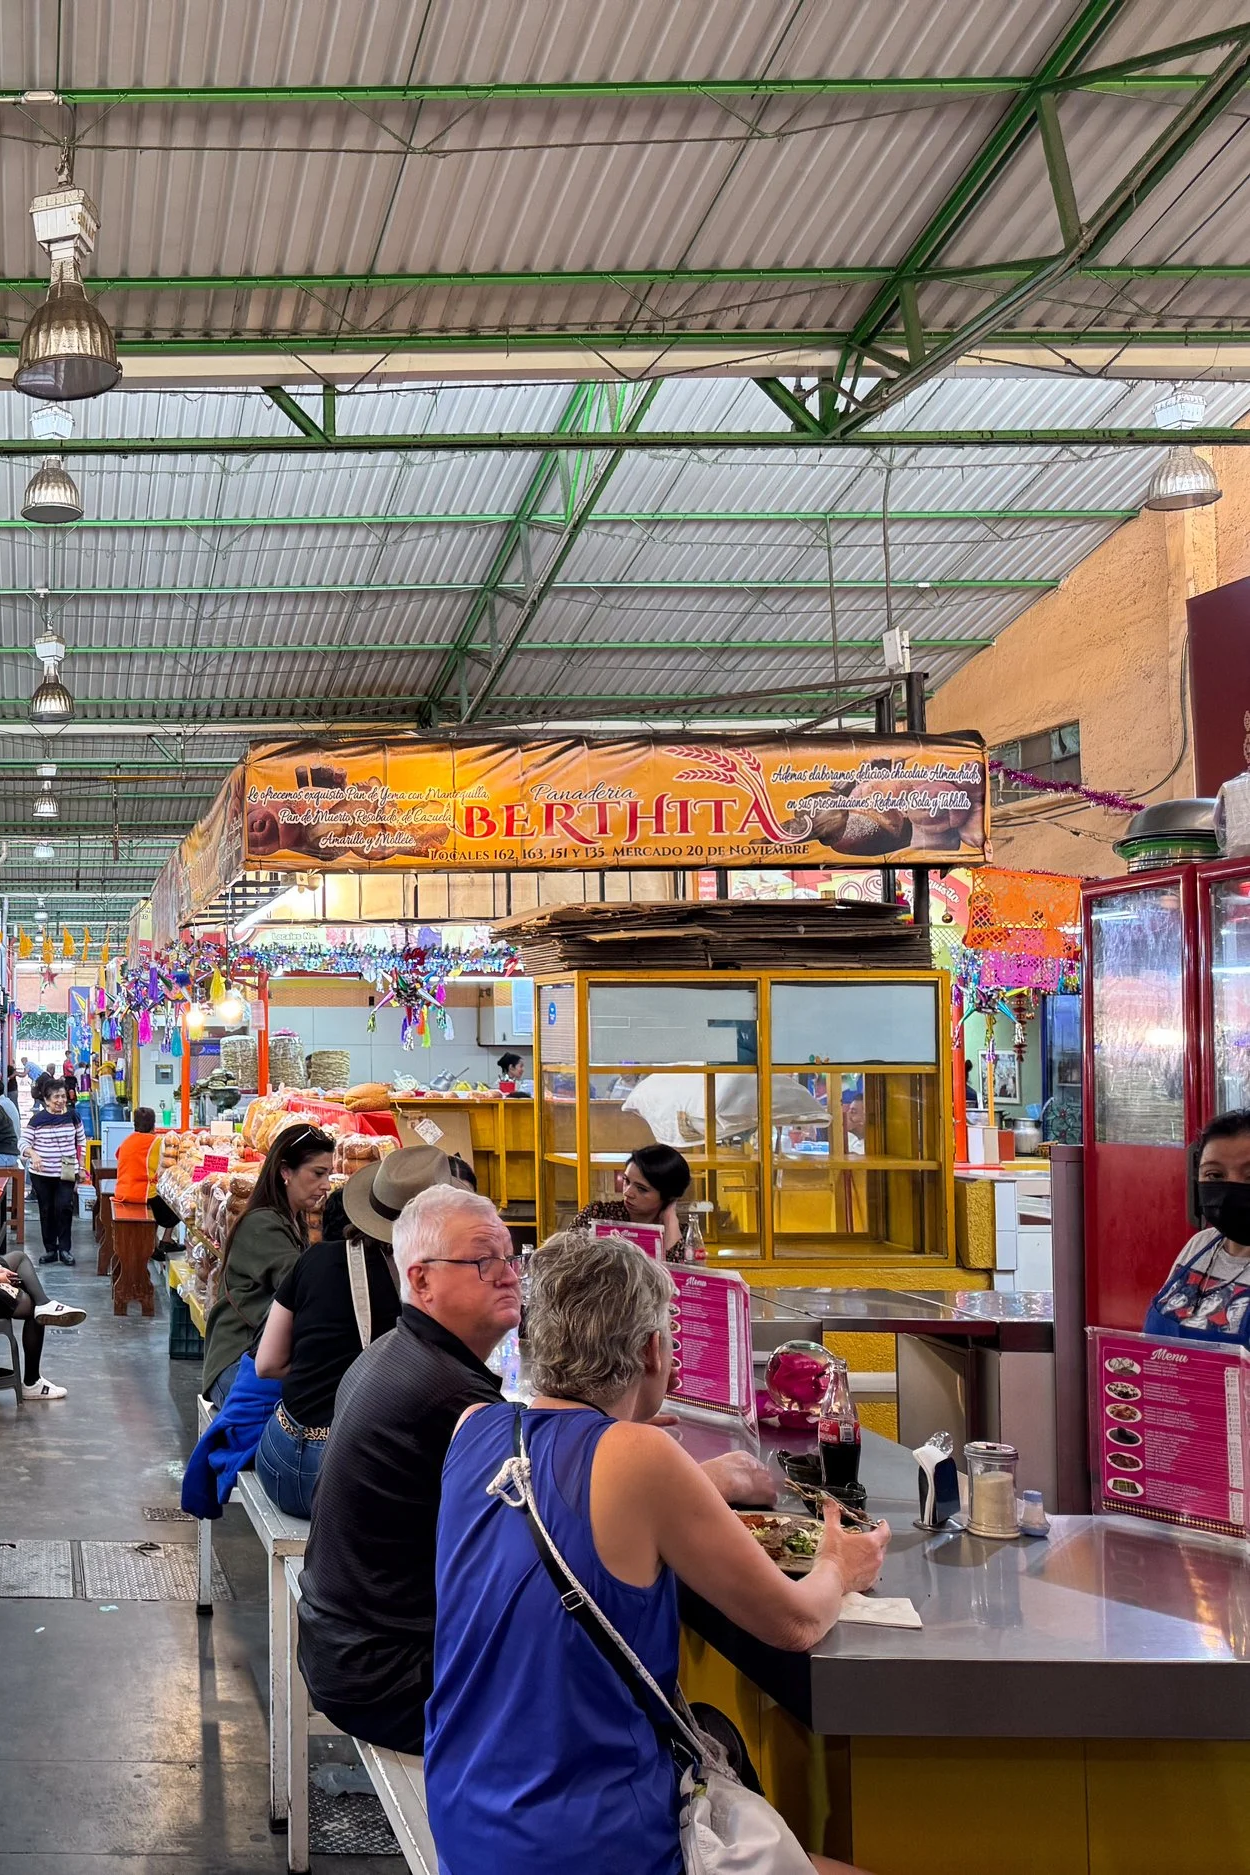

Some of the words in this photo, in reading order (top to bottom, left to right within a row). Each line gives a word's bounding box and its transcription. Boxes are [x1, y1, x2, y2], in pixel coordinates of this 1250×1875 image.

[808, 765, 854, 781] elaboramos
[855, 763, 890, 782] delicioso
[891, 765, 928, 780] chocolate
[928, 764, 980, 784] Almendrado,
[248, 786, 260, 801] Le
[260, 788, 302, 807] ofrecemos
[305, 787, 345, 807] exquisito
[346, 788, 366, 801] Pan
[366, 787, 379, 801] de
[379, 787, 406, 807] Yema
[407, 790, 424, 801] con
[425, 786, 490, 806] Mantequilla,
[786, 800, 797, 810] en
[798, 797, 812, 810] sus
[872, 791, 909, 811] Redondo,
[911, 791, 930, 810] Bola
[930, 797, 938, 816] y
[938, 791, 971, 809] Tablilla
[280, 809, 300, 824] Pan
[300, 809, 313, 824] de
[313, 809, 353, 825] Muerto,
[400, 808, 414, 824] de
[456, 794, 812, 847] BERTHITA
[319, 832, 365, 848] Amarillo
[364, 837, 373, 854] y
[550, 848, 568, 859] 151
[572, 848, 581, 858] Y
[585, 847, 605, 858] 135
[686, 845, 704, 857] 20
